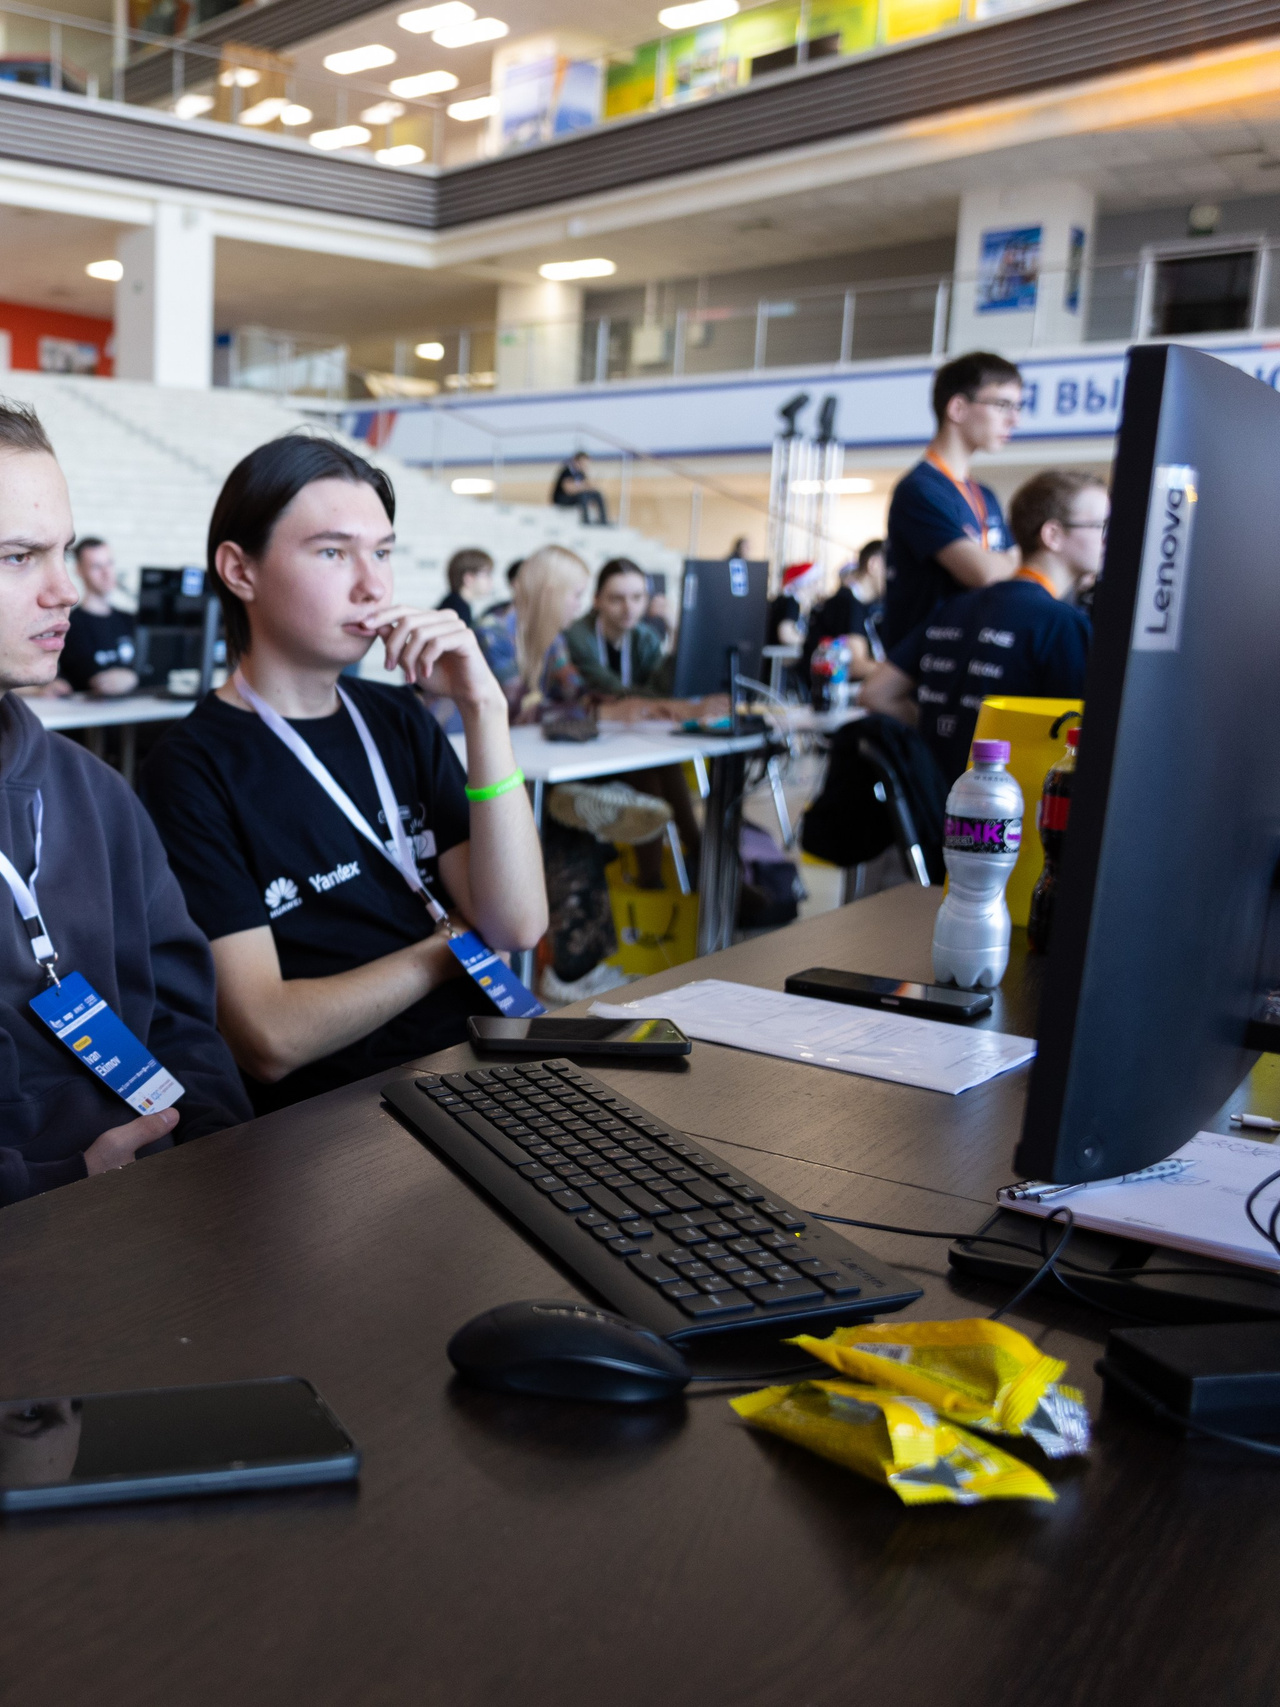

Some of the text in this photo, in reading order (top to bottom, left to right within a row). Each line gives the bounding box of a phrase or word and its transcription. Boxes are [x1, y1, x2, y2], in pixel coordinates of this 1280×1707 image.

[1144, 488, 1184, 635] Lenovo
[309, 861, 361, 893] Yandex
[270, 897, 302, 919] HUAWEI
[82, 1050, 102, 1066] Ivan
[94, 1055, 122, 1077] Ekimov
